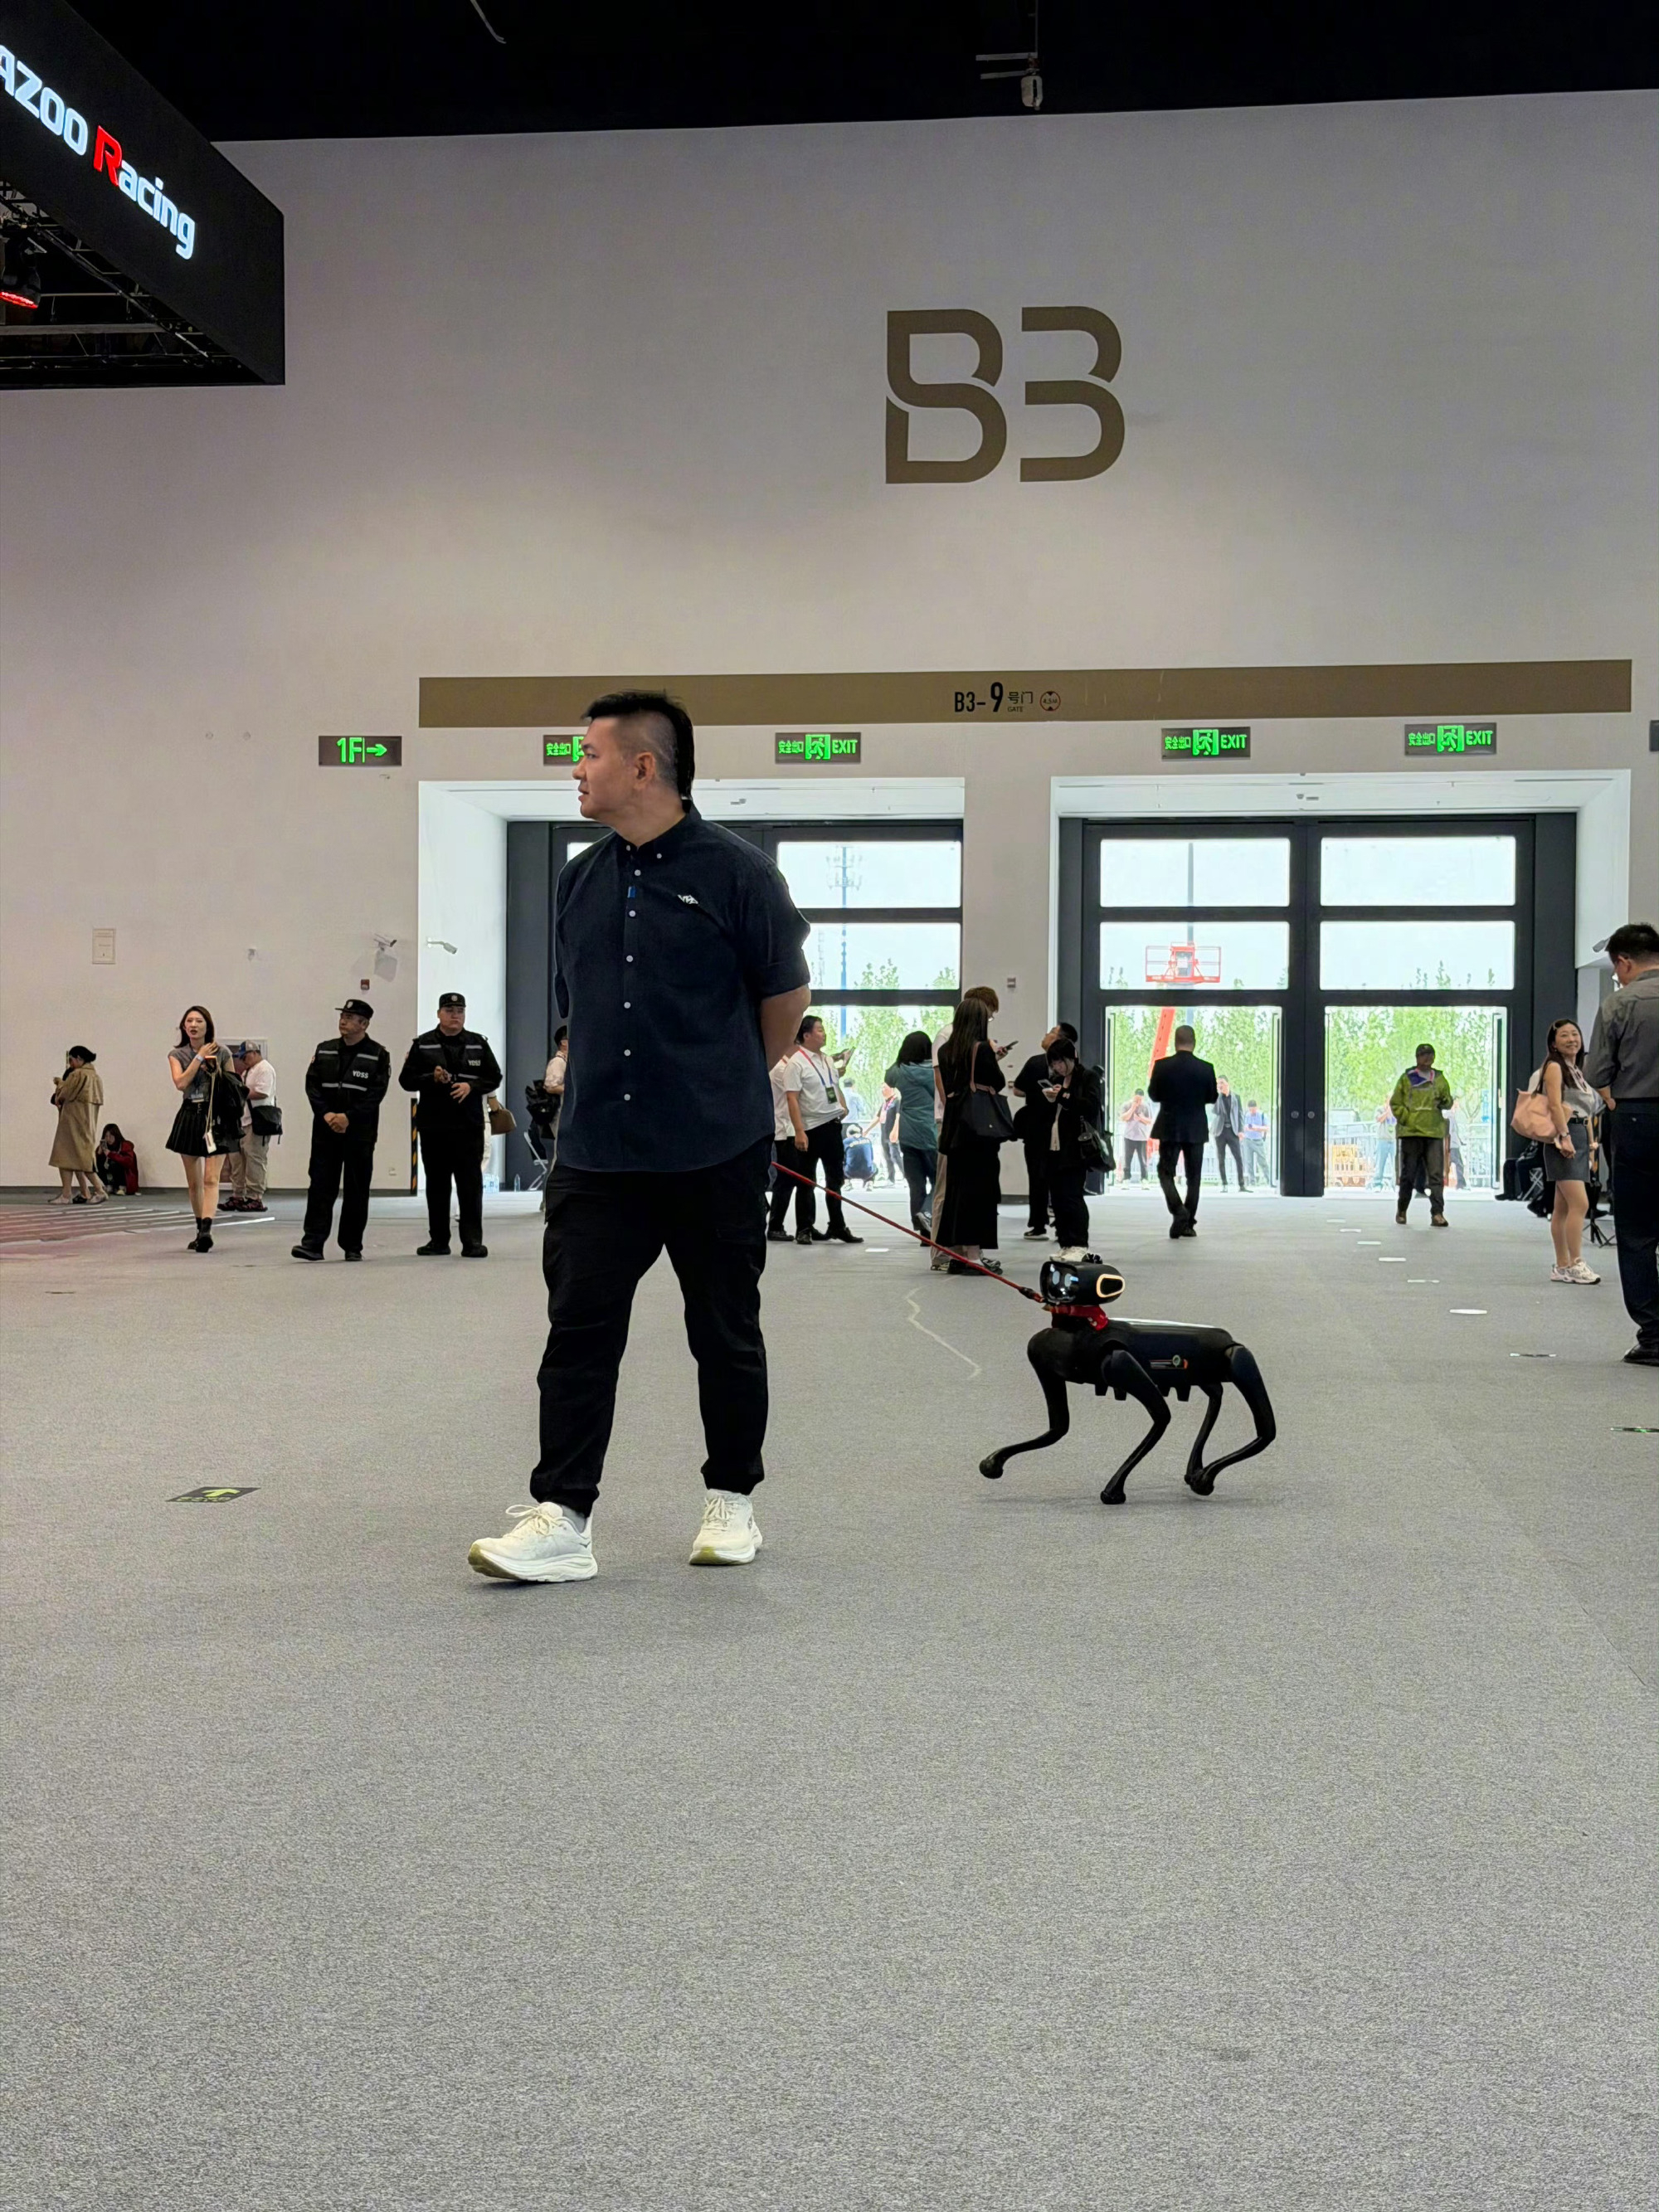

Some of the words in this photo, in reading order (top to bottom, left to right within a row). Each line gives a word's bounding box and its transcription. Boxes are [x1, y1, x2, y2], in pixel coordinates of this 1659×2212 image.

[93, 125, 196, 260] Racing
[885, 306, 1125, 484] B3
[1007, 691, 1034, 705] 号门
[1165, 736, 1191, 750] 安全出口
[1220, 734, 1247, 749] EXIT
[1408, 732, 1436, 746] 安全出口
[1466, 730, 1493, 746] EXIT
[337, 737, 362, 763] 1F
[832, 739, 858, 754] EXIT
